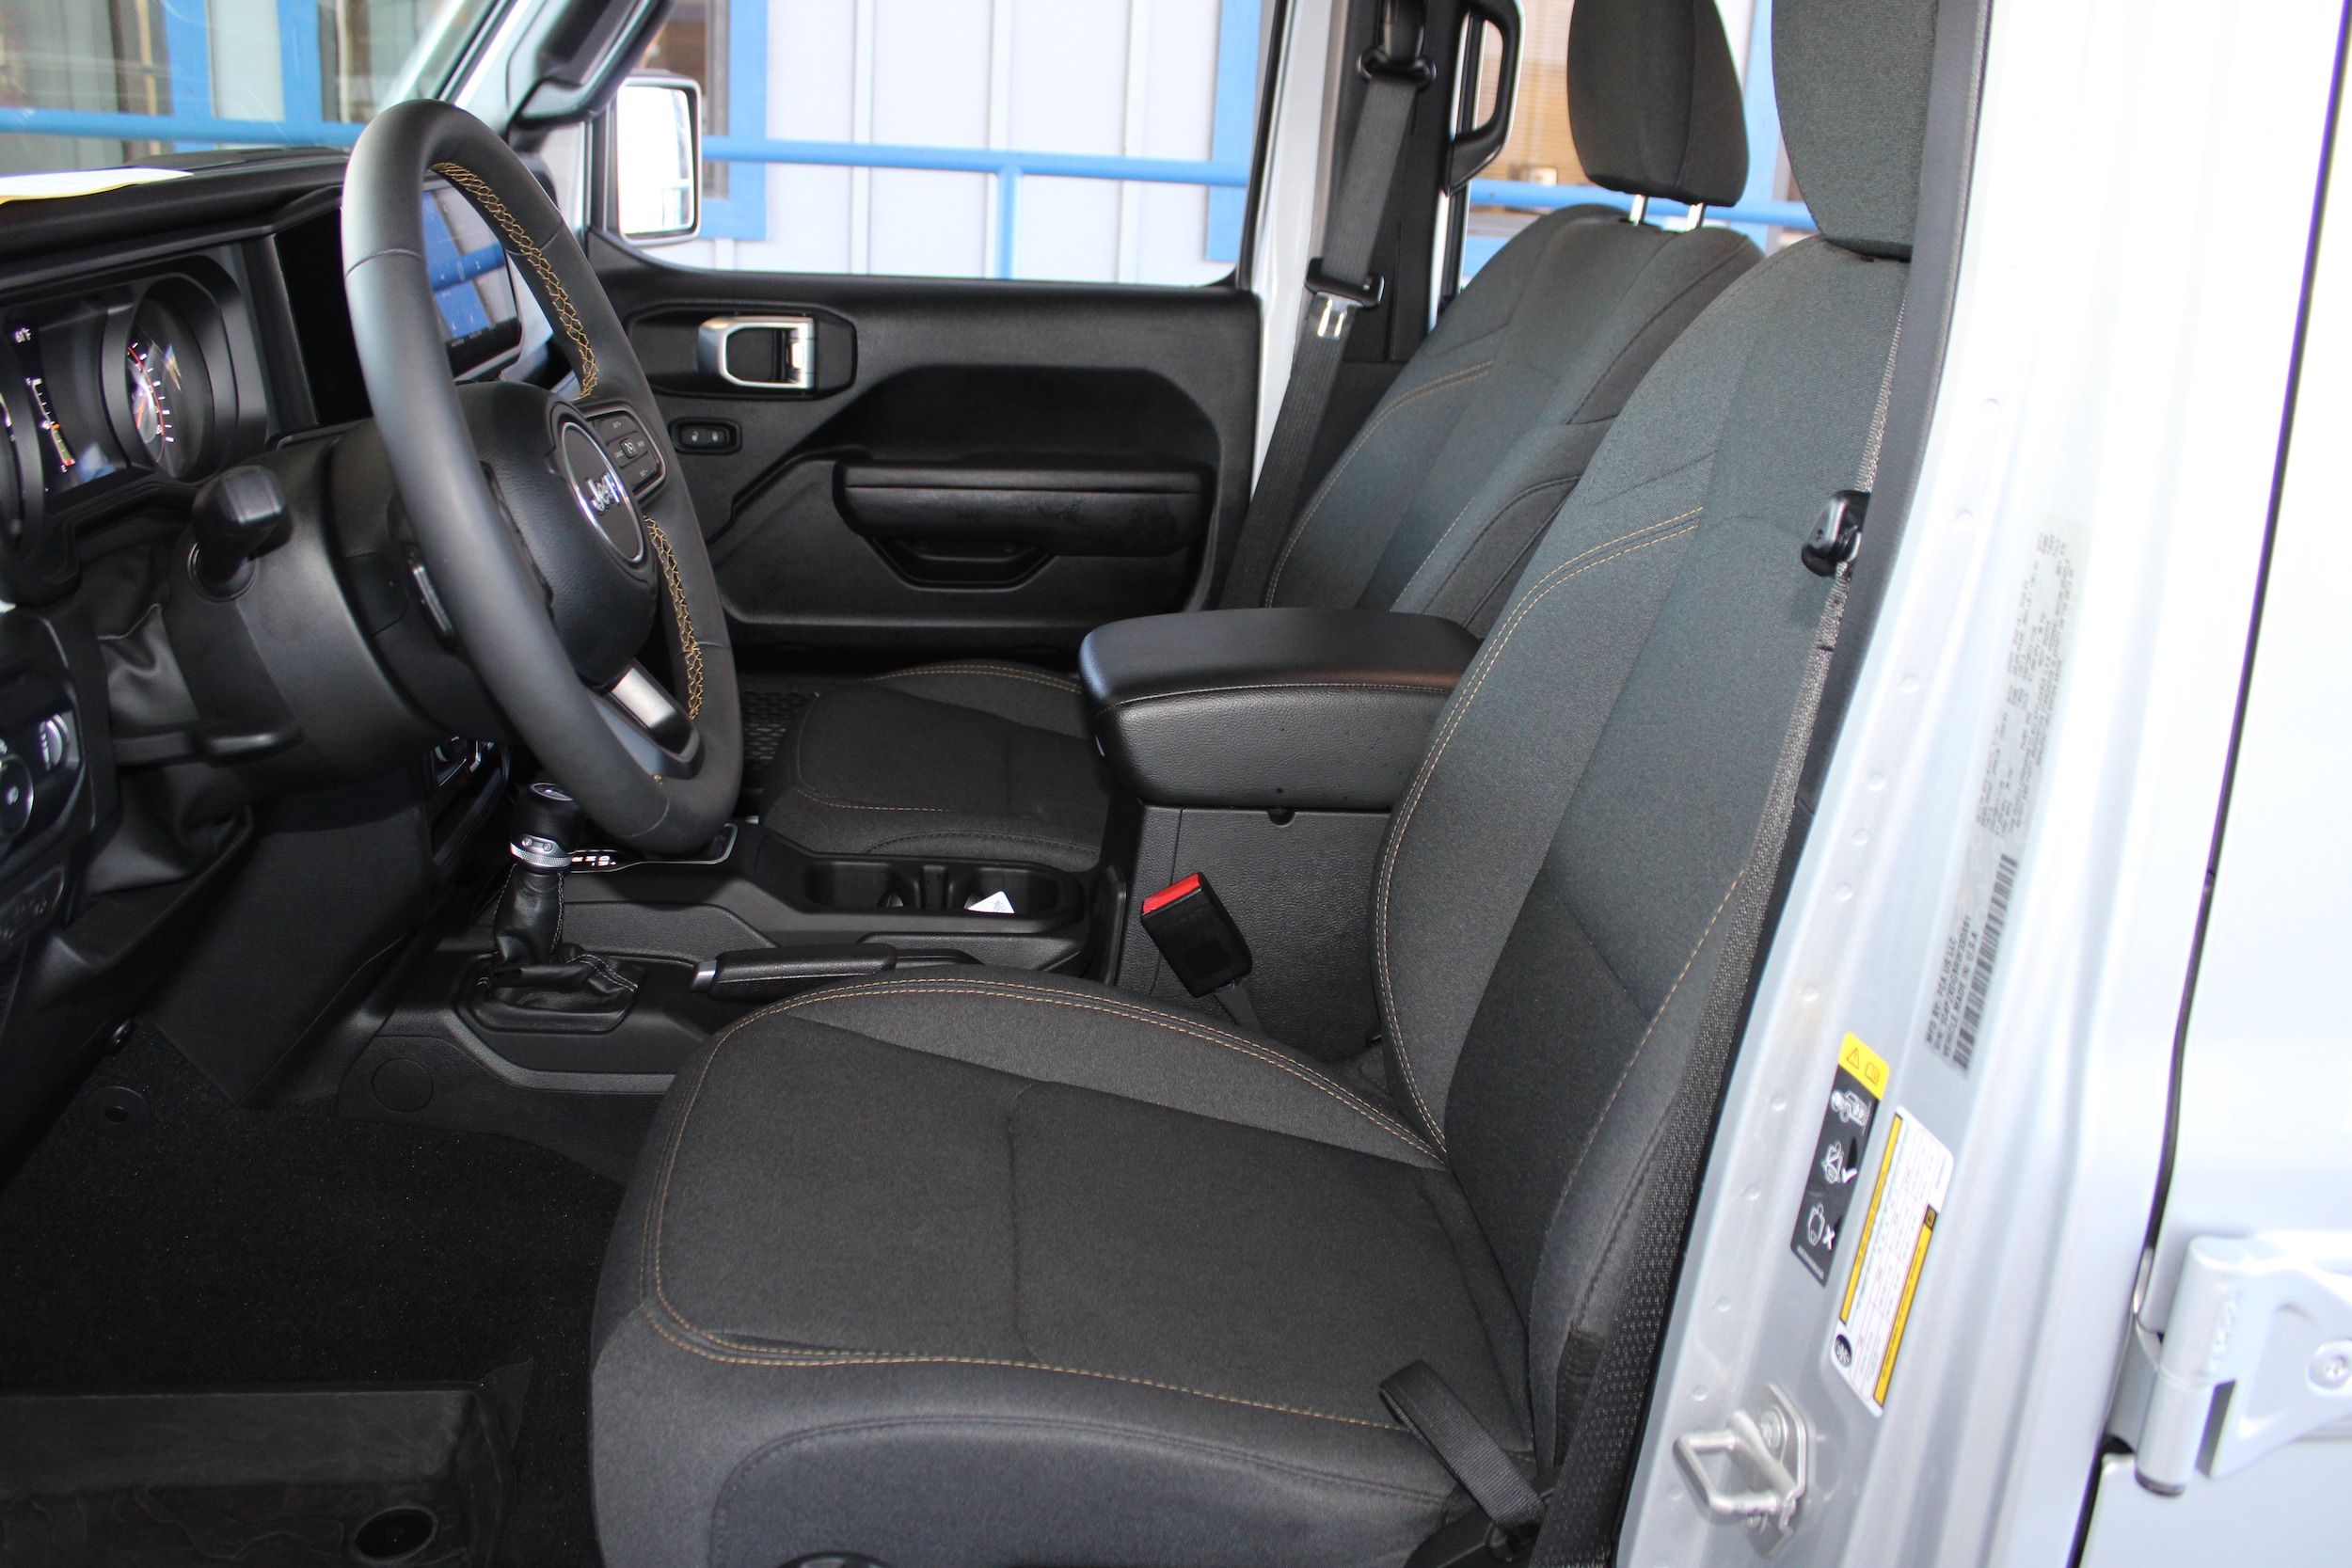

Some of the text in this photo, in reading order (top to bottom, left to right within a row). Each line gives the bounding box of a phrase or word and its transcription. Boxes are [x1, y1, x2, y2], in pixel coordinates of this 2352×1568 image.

[587, 473, 620, 511] Jeep
[1947, 936, 1957, 958] LLC
[1943, 958, 1952, 974] US
[1938, 976, 1947, 997] FCA
[1943, 1014, 1959, 1057] VEHICLE
[1954, 982, 1967, 1014] MADE
